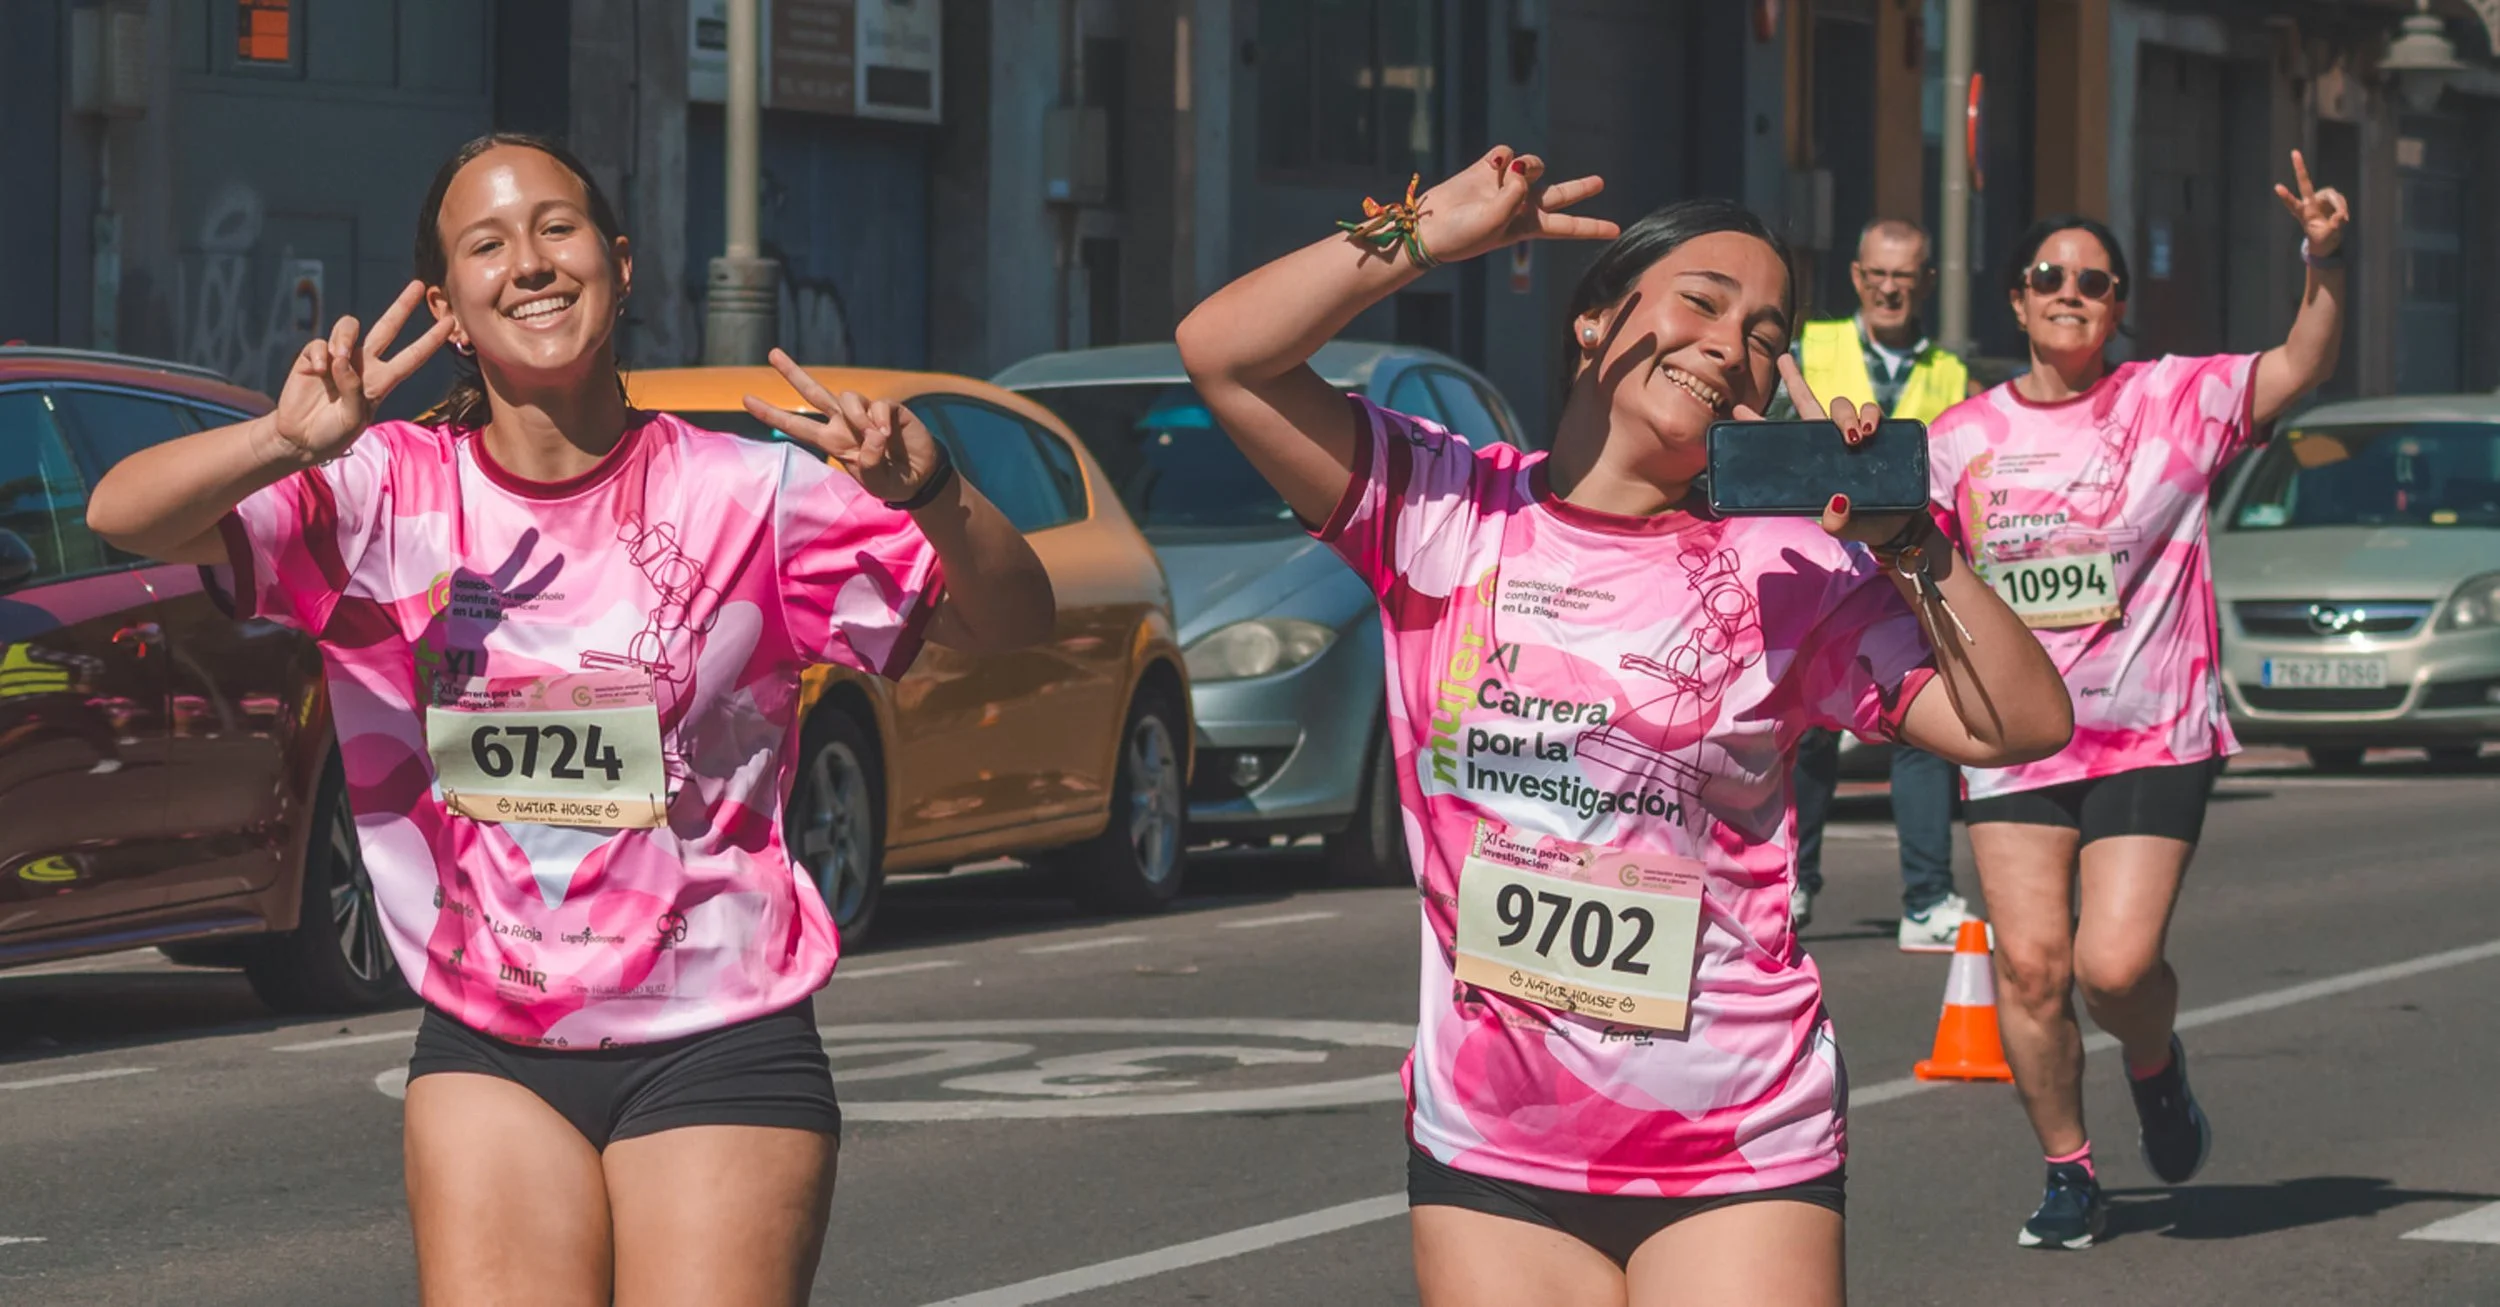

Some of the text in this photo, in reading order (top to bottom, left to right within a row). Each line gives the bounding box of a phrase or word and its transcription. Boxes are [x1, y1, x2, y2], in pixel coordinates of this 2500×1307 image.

[1988, 488, 2008, 507] XI
[1986, 510, 2066, 530] Carrera
[1508, 579, 1616, 603] asociación española
[2001, 563, 2108, 605] 10994
[1501, 603, 1560, 619] en La Rioja
[1505, 591, 1590, 611] contra el cáncer
[1486, 642, 1521, 674] XI
[1431, 623, 1486, 788] mujer
[1476, 678, 1609, 727] Carrera
[471, 724, 624, 781] 6724
[1467, 726, 1569, 763] por la
[514, 801, 603, 816] NATUR HOUSE
[1466, 761, 1685, 827] Investigación
[1485, 832, 1570, 863] XI Carrera por la
[493, 920, 543, 942] La Rioja
[1496, 884, 1655, 976] 9702
[1524, 977, 1568, 999] NATUR
[1570, 989, 1617, 1009] HOUSE
